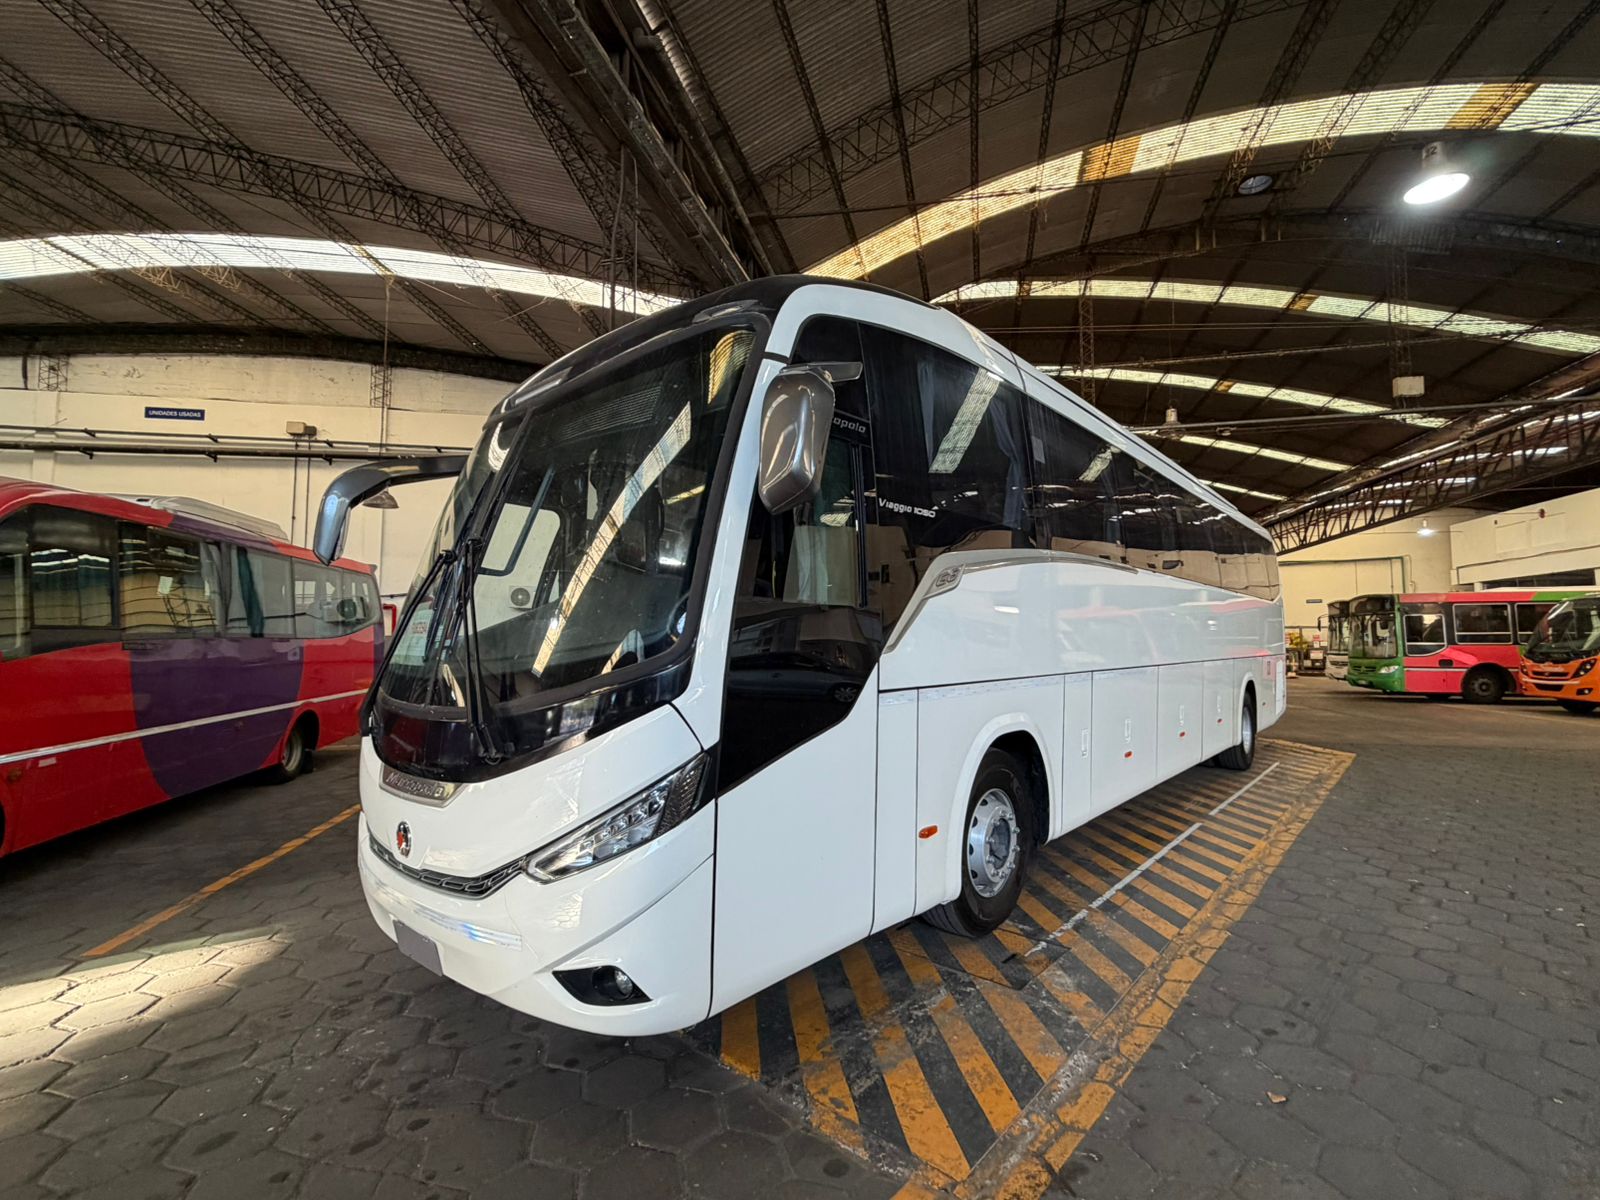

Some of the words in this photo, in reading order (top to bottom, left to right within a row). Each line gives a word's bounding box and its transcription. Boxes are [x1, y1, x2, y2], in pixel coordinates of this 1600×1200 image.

[833, 417, 866, 433] opolo
[878, 497, 913, 513] Viaggio
[913, 506, 936, 518] 1050
